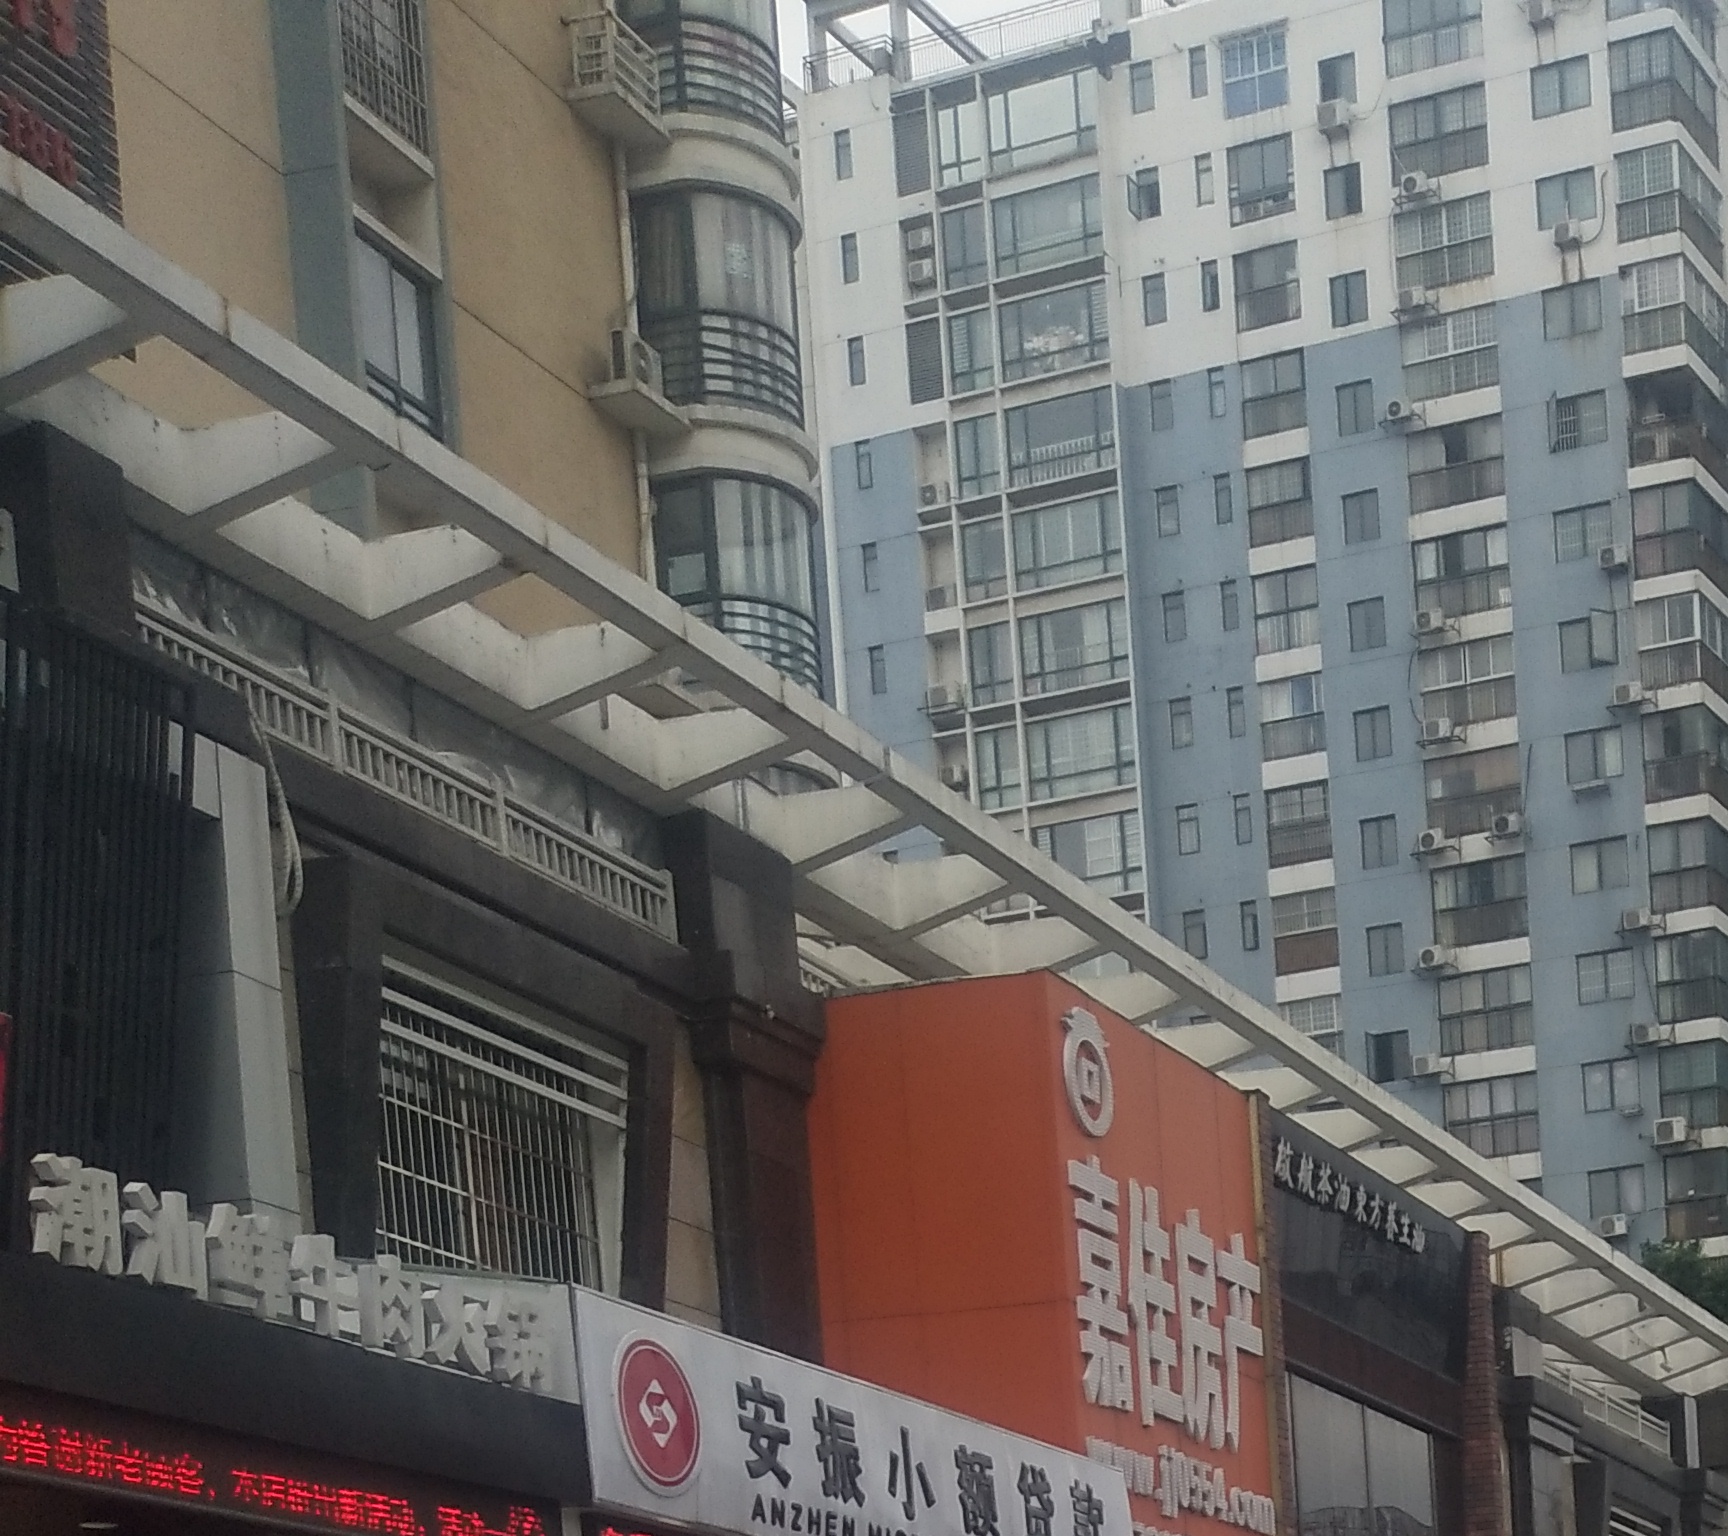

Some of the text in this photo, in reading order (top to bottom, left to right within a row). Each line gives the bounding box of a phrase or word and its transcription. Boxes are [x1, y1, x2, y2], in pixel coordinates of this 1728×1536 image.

[29, 1152, 556, 1393] 潮汕鲜牛肉火锅
[1067, 1154, 1264, 1454] 嘉佳房产
